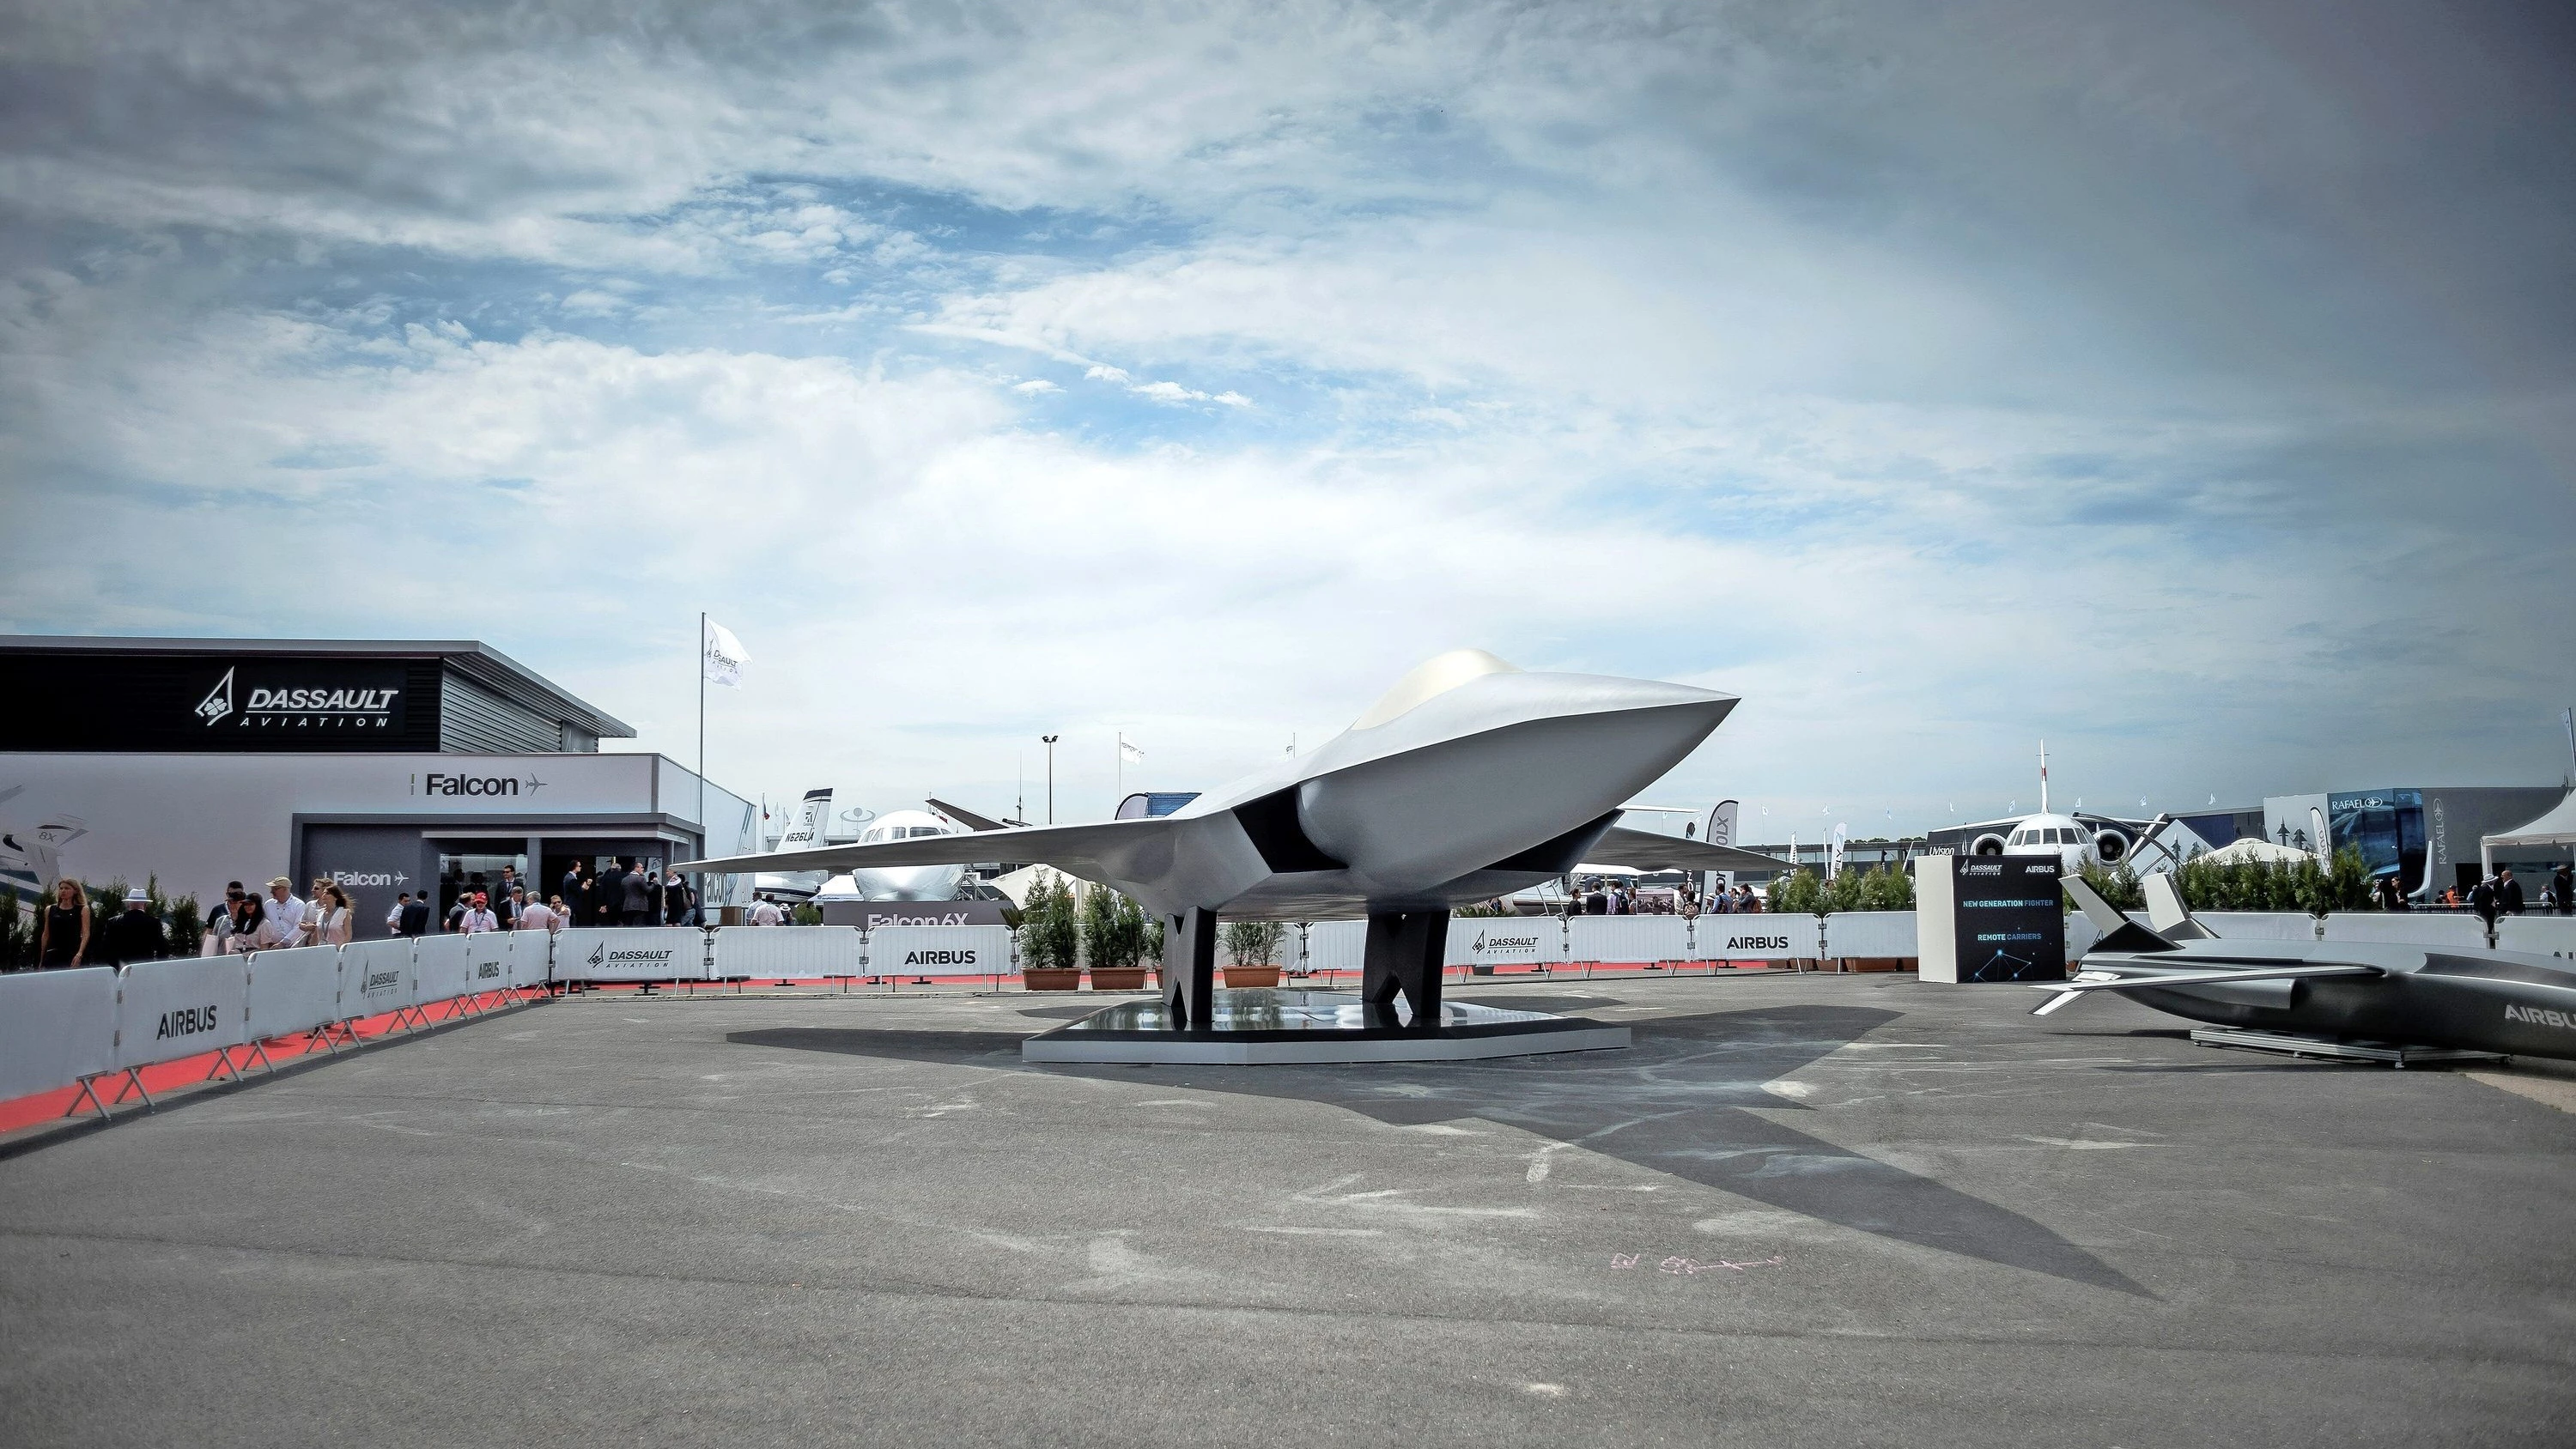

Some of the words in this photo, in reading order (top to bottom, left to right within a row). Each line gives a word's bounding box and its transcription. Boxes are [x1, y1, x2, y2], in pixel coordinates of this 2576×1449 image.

[247, 689, 398, 709] DASSAULT
[240, 717, 387, 727] AVIATION
[427, 774, 519, 796] Falcon
[2332, 799, 2364, 810] RAFAEL
[39, 831, 57, 842] 8X
[786, 832, 815, 842] N626LA
[2435, 822, 2447, 864] RAFAEL
[333, 871, 392, 886] Falcon
[1489, 937, 1539, 947] DASSAULT
[1726, 937, 1789, 949] AIRBUS
[609, 950, 672, 960] DASSAULT
[904, 950, 976, 965] AIRBUS
[478, 961, 500, 979] AIRBUS
[369, 971, 398, 986] DASSAULT
[156, 1005, 217, 1040] AIRBUS
